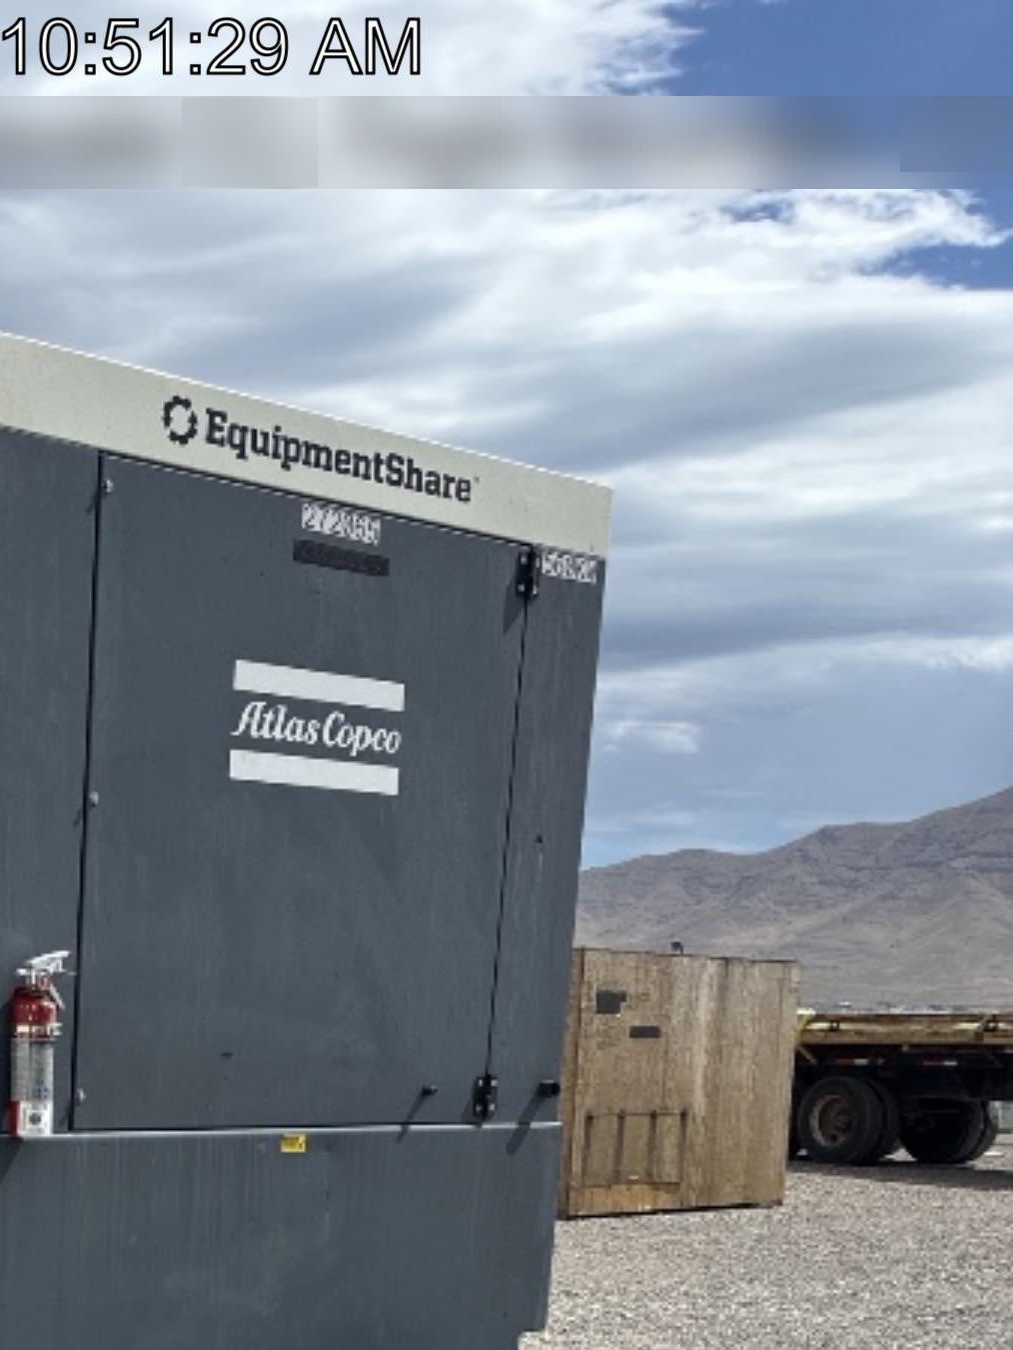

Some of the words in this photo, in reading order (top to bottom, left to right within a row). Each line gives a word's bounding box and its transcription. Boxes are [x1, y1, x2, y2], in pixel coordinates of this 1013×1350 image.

[205, 407, 472, 503] EquipmentShare
[230, 700, 321, 746] Atlas
[322, 710, 403, 757] Copco
